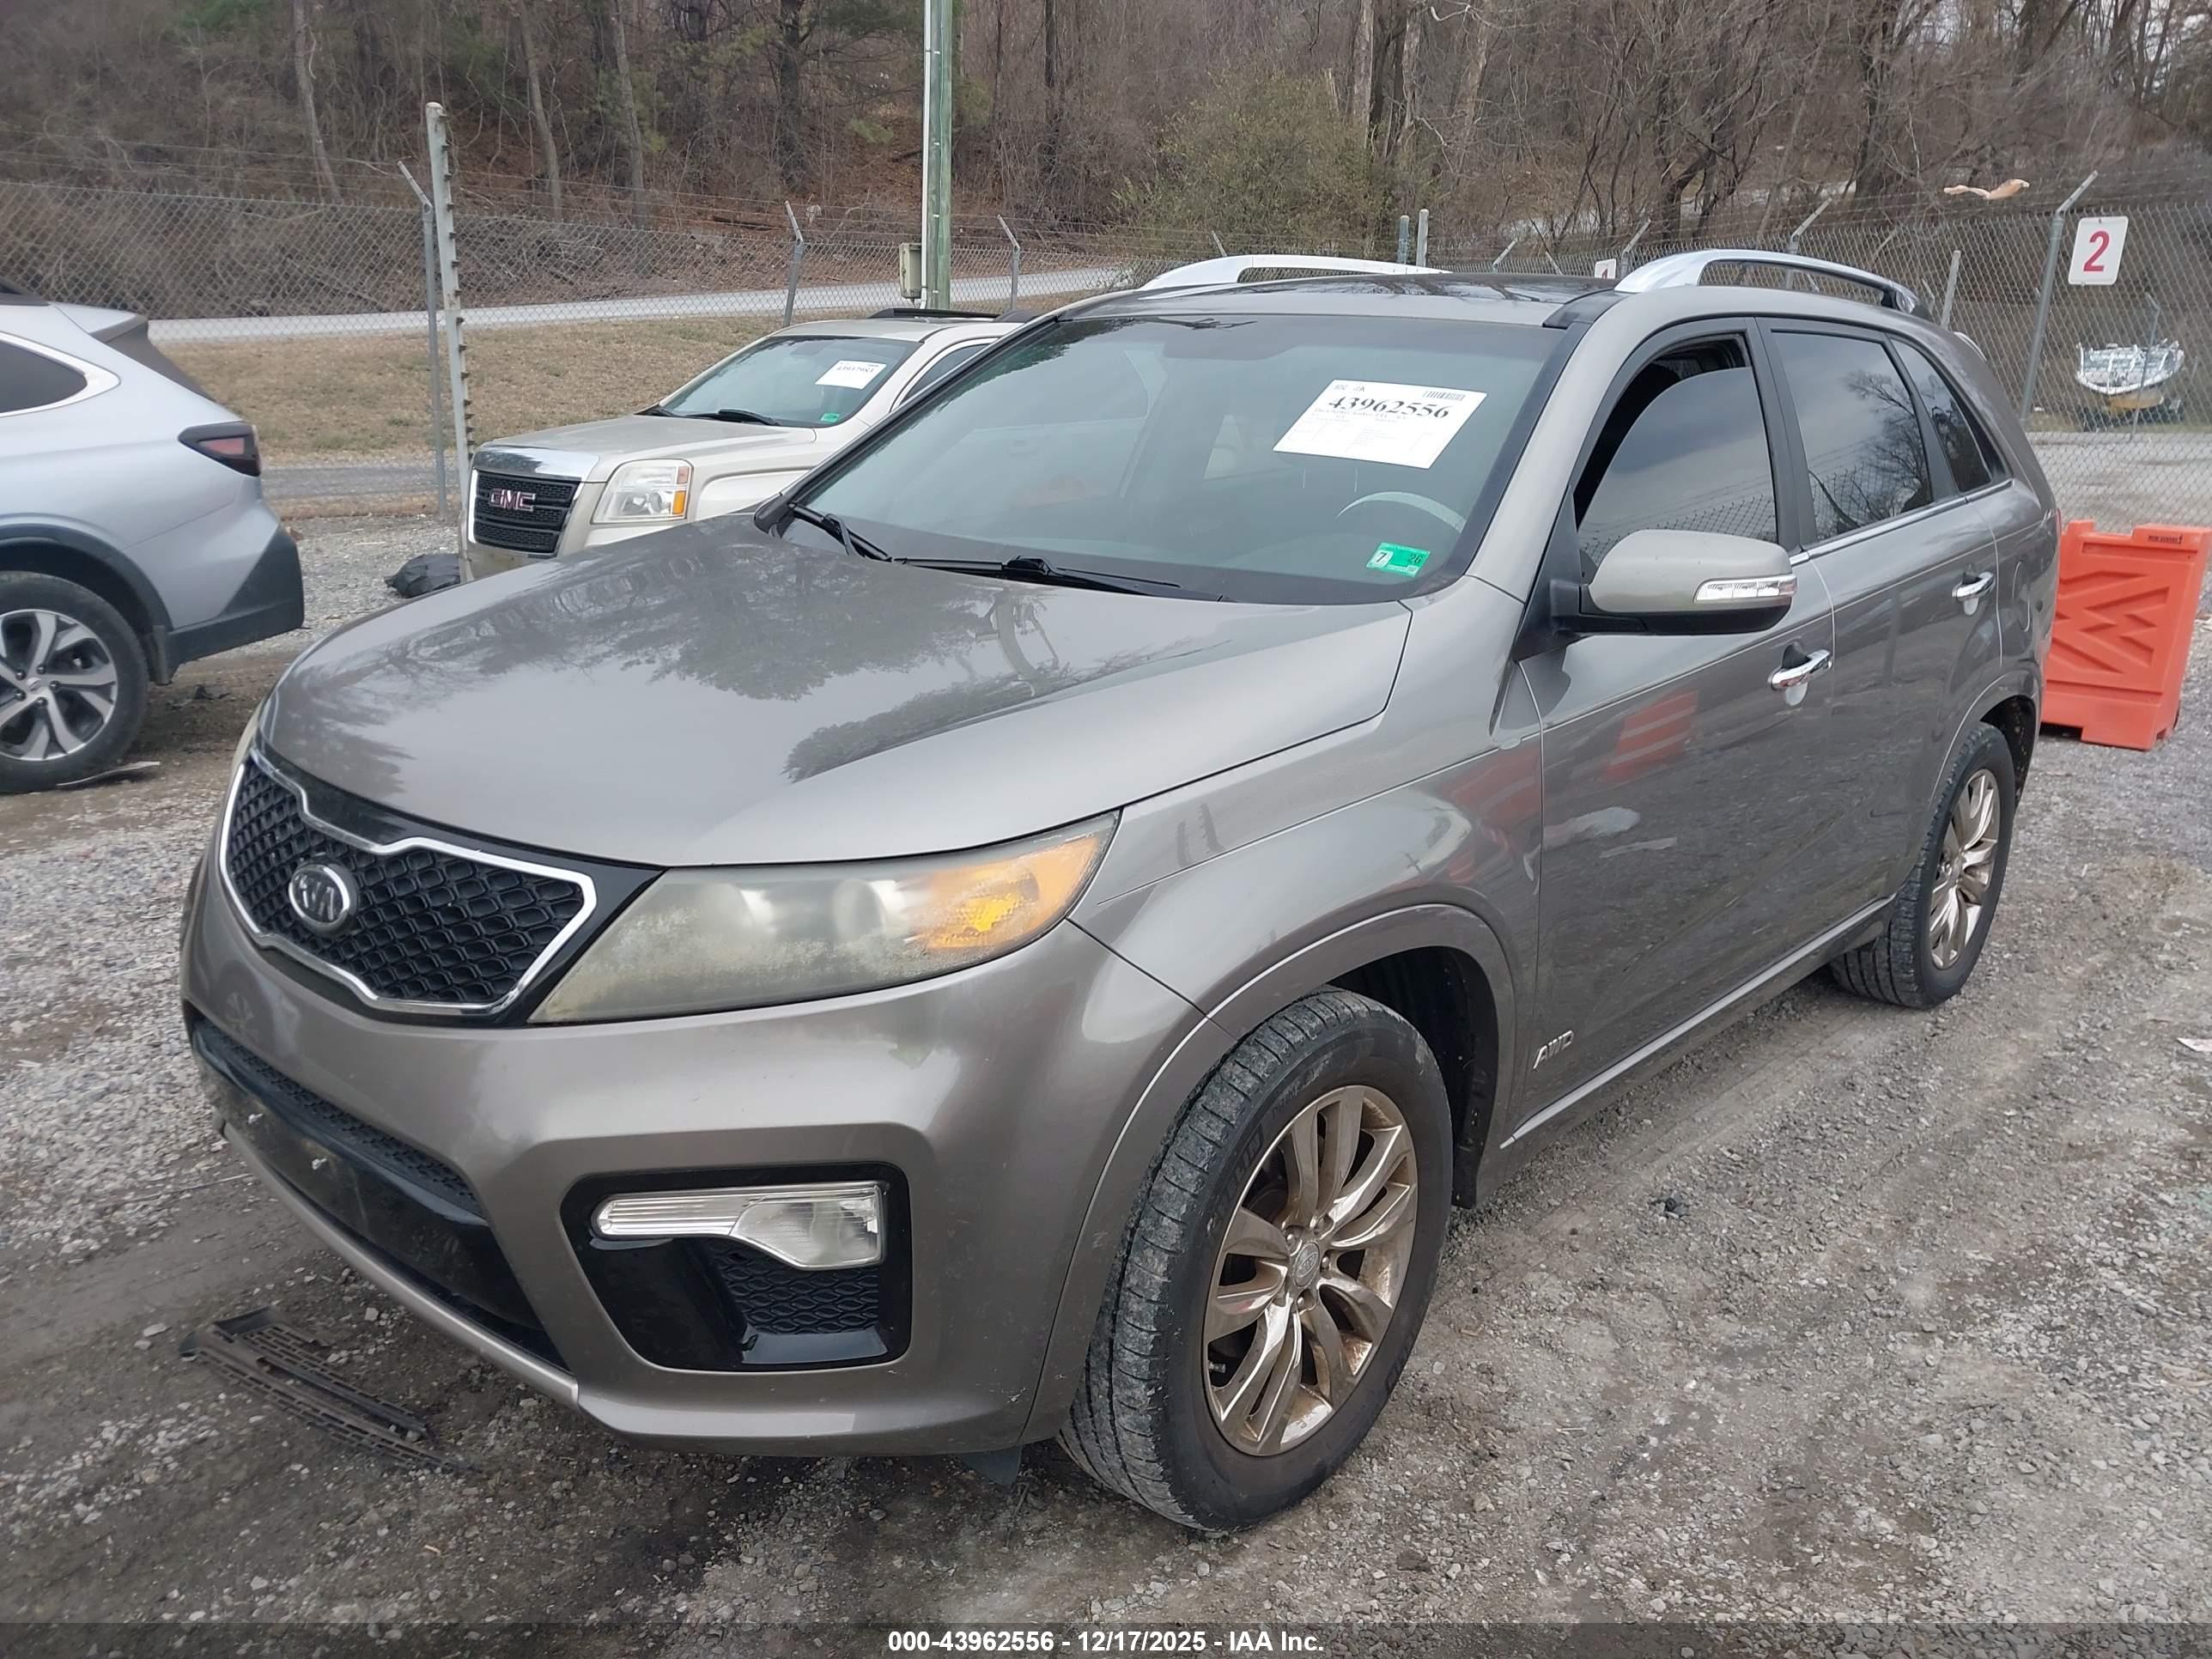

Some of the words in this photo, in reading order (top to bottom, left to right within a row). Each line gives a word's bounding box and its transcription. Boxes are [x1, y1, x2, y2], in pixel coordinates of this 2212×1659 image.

[2083, 231, 2110, 271] 2
[1328, 396, 1454, 419] 43962556
[489, 488, 536, 513] GMC
[1376, 551, 1388, 563] 7
[1533, 1030, 1574, 1069] AWD
